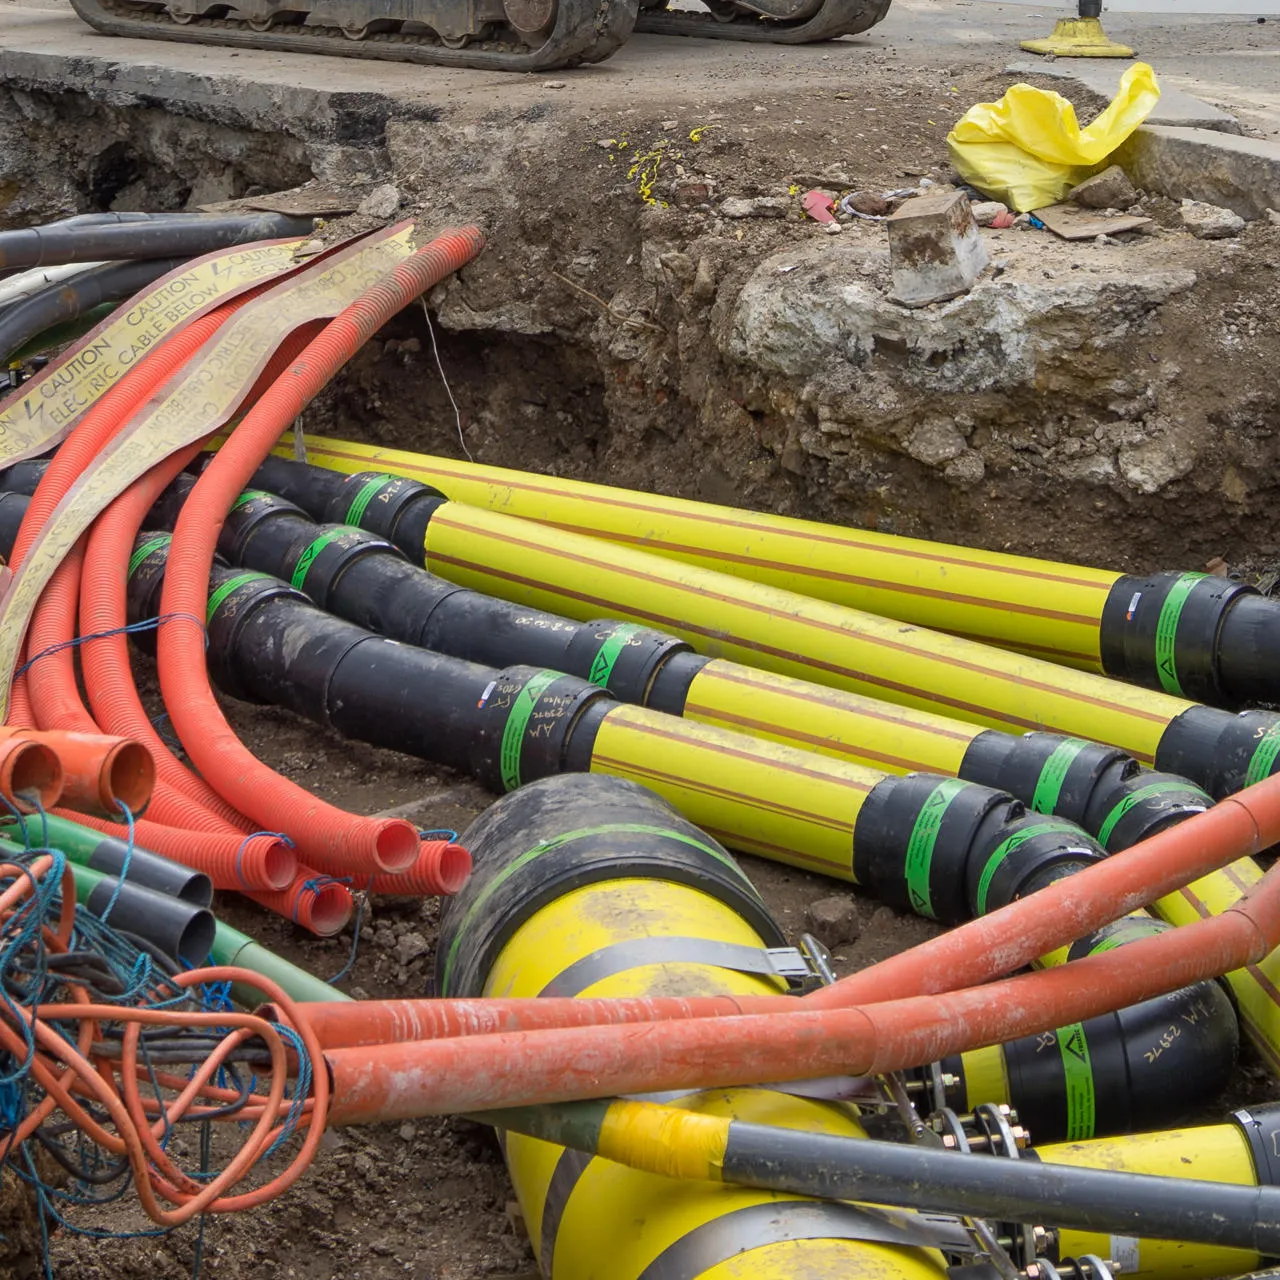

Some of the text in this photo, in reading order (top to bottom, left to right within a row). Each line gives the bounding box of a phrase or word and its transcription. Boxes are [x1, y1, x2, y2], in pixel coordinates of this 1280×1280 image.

[118, 322, 168, 365] CABLE
[164, 282, 220, 324] BELOW
[126, 273, 200, 328] CAUTION
[40, 337, 113, 400] CAUTION
